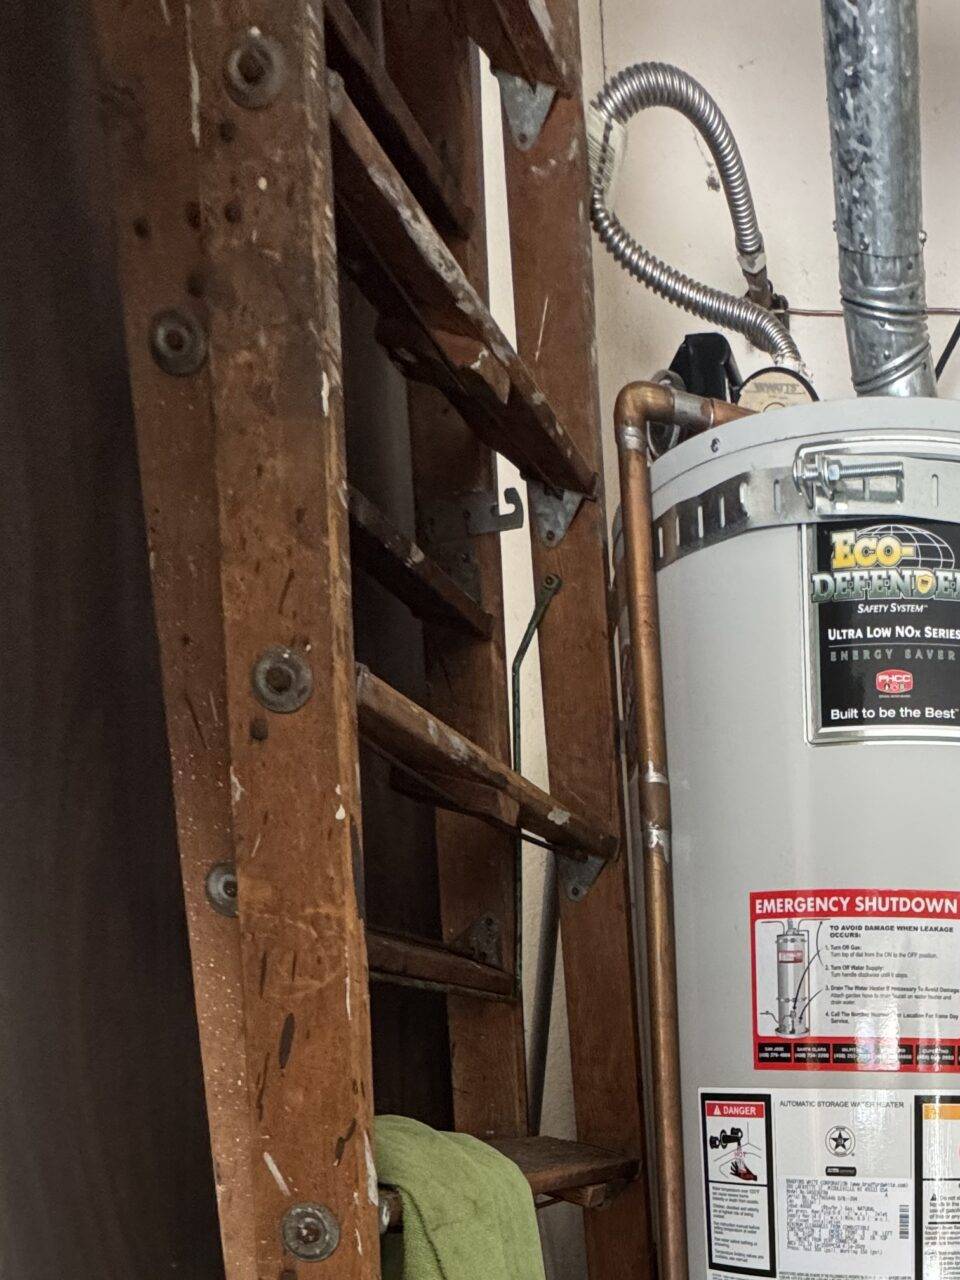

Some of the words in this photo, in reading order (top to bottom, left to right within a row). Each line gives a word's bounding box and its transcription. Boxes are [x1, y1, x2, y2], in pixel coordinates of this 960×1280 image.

[858, 603, 889, 613] SAFETY
[828, 628, 863, 641] ULTRA
[867, 626, 890, 639] LOW
[925, 626, 960, 640] SERIES
[830, 649, 893, 662] ENERGY
[905, 649, 956, 661] SAVER
[831, 709, 858, 720] Built
[862, 709, 875, 719] to
[879, 707, 896, 718] be
[900, 707, 921, 718] the
[756, 897, 850, 915] EMERGENCY
[855, 896, 958, 914] SHUTDOWN
[723, 1106, 756, 1115] DANGER
